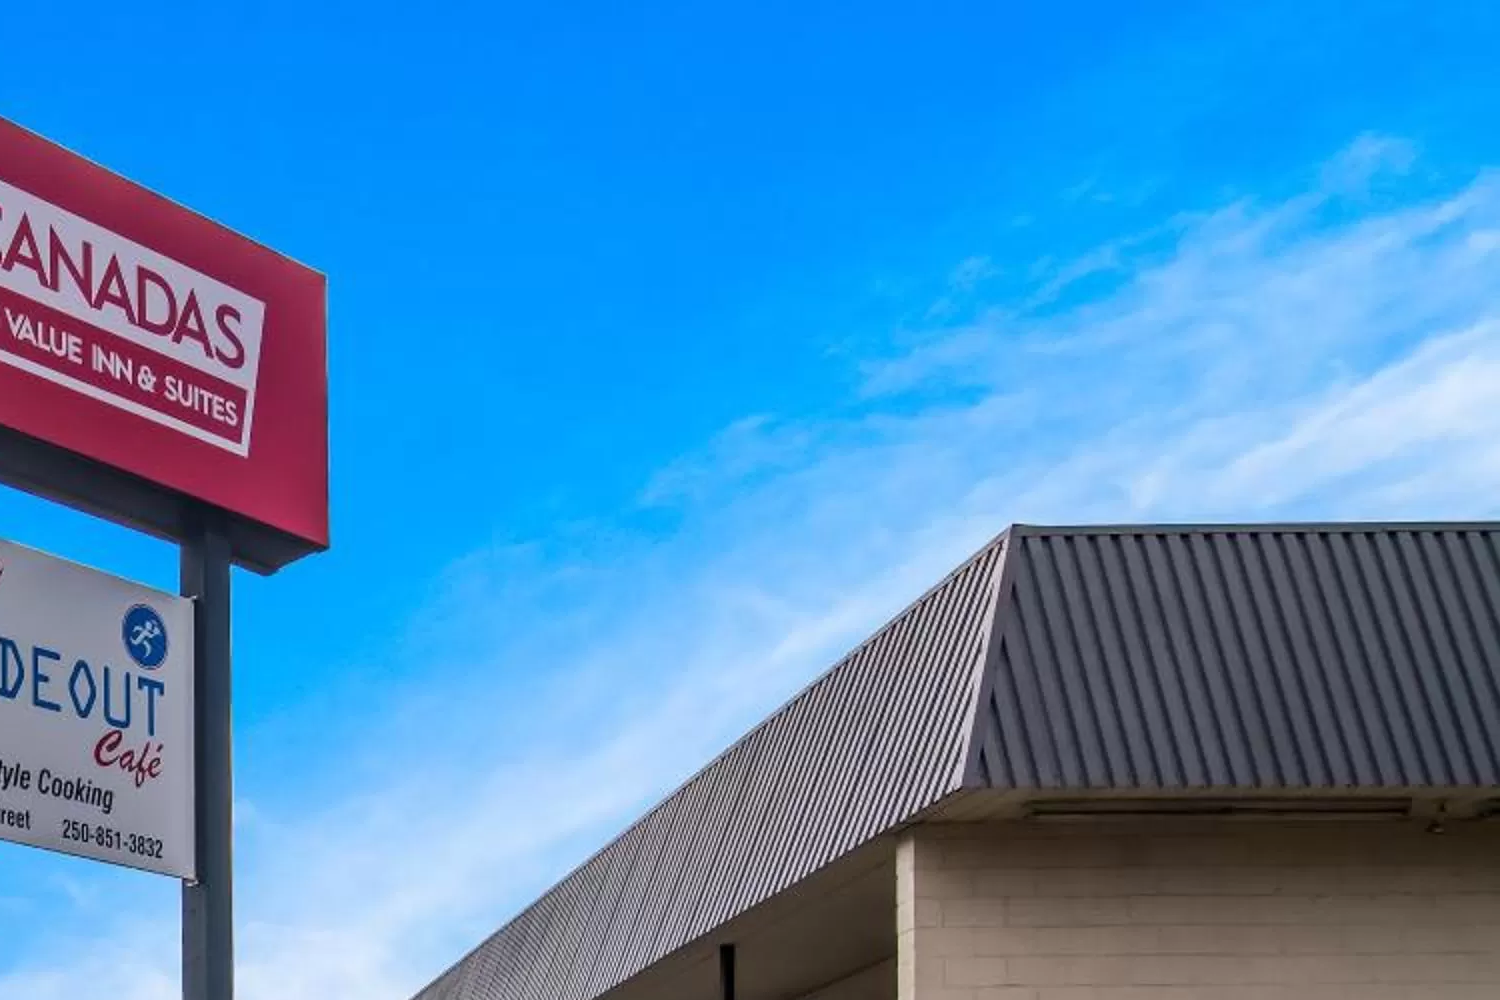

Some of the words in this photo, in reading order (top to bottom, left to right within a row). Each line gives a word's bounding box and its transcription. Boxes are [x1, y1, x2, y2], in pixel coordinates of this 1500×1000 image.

[4, 307, 83, 362] VALUE
[91, 343, 133, 385] INN
[137, 365, 157, 393] &
[164, 374, 238, 427] SUITES
[93, 729, 164, 789] Café
[37, 768, 114, 815] Cooking
[62, 818, 164, 859] 250-851-3832
